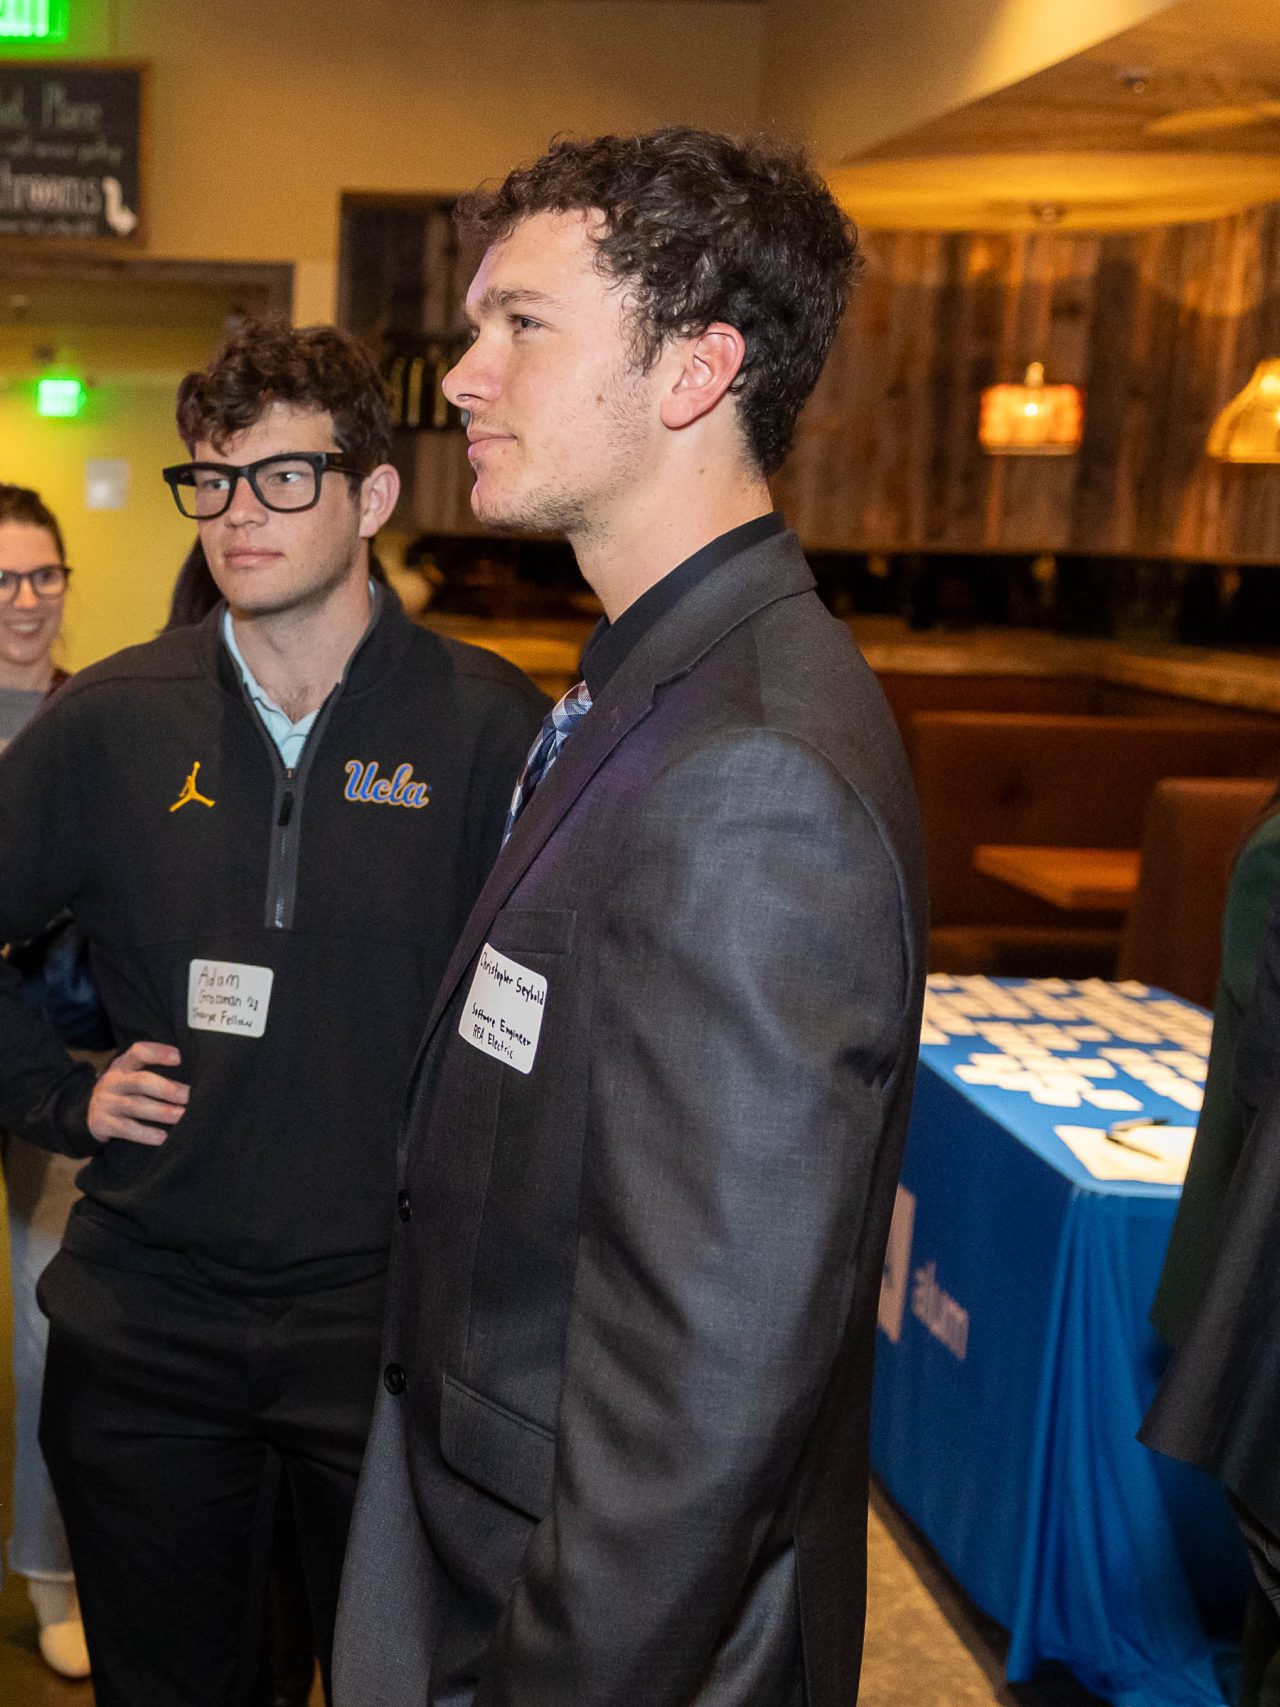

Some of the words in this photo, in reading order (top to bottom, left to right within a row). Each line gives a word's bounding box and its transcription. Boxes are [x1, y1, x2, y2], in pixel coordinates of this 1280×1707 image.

[344, 759, 430, 809] Ucla
[198, 965, 240, 990] Adam
[480, 951, 513, 987] Christopher
[516, 977, 545, 1006] Seybold
[220, 1009, 254, 1028] Fellow
[472, 1002, 496, 1028] Software
[500, 1018, 532, 1047] Engineer
[488, 1032, 514, 1060] Electric
